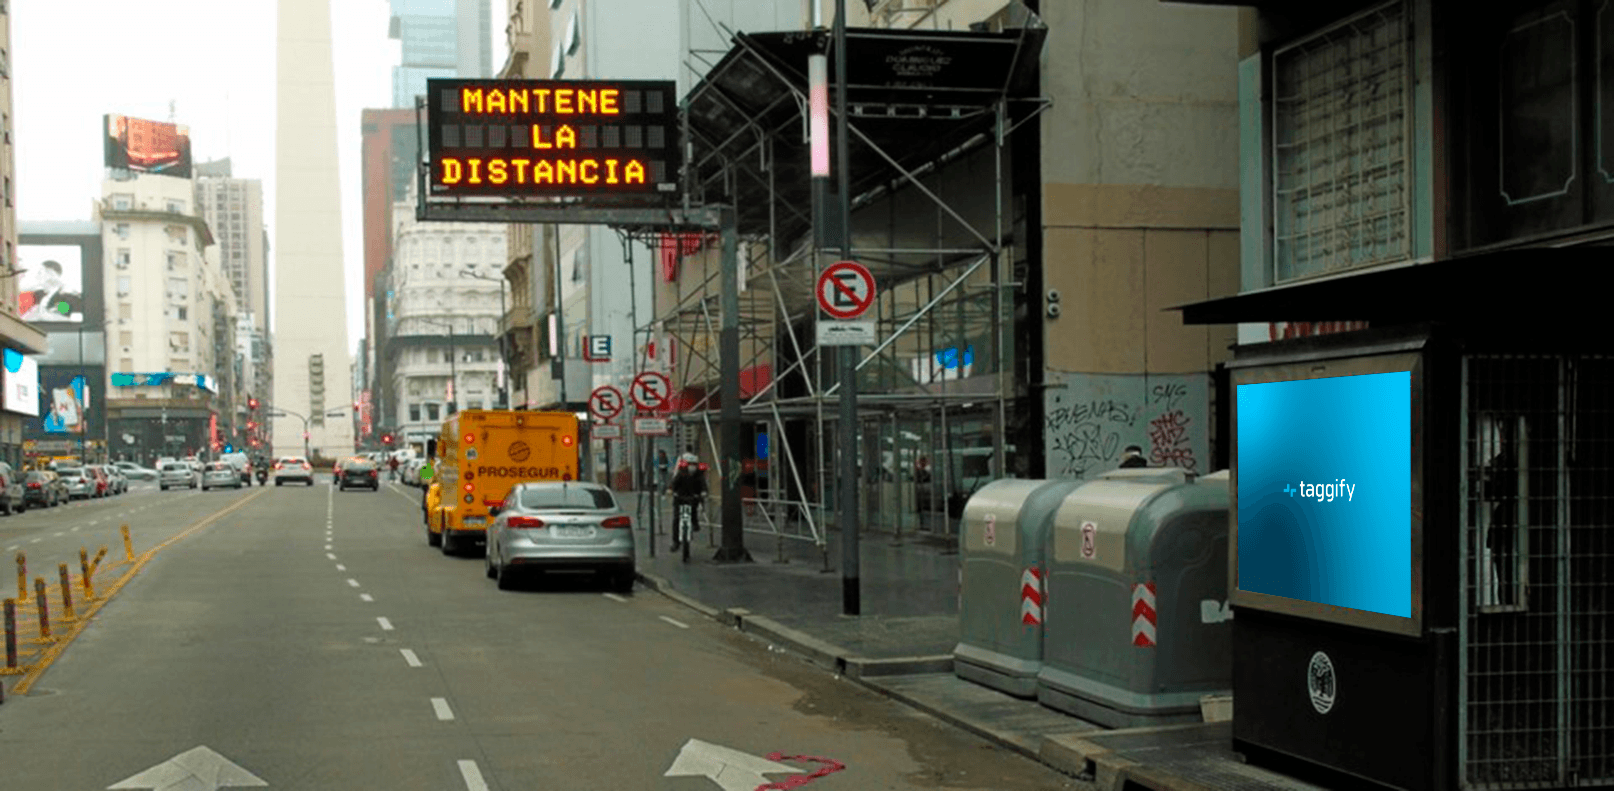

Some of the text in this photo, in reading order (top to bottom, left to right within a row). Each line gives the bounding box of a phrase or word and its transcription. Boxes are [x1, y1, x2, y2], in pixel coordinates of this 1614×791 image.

[462, 88, 619, 114] MANTENE
[532, 123, 576, 149] LA
[441, 158, 645, 184] DISTANCIA
[833, 273, 857, 307] E
[643, 380, 658, 400] E
[477, 466, 560, 478] PROSEGUR
[1300, 478, 1356, 502] taggify
